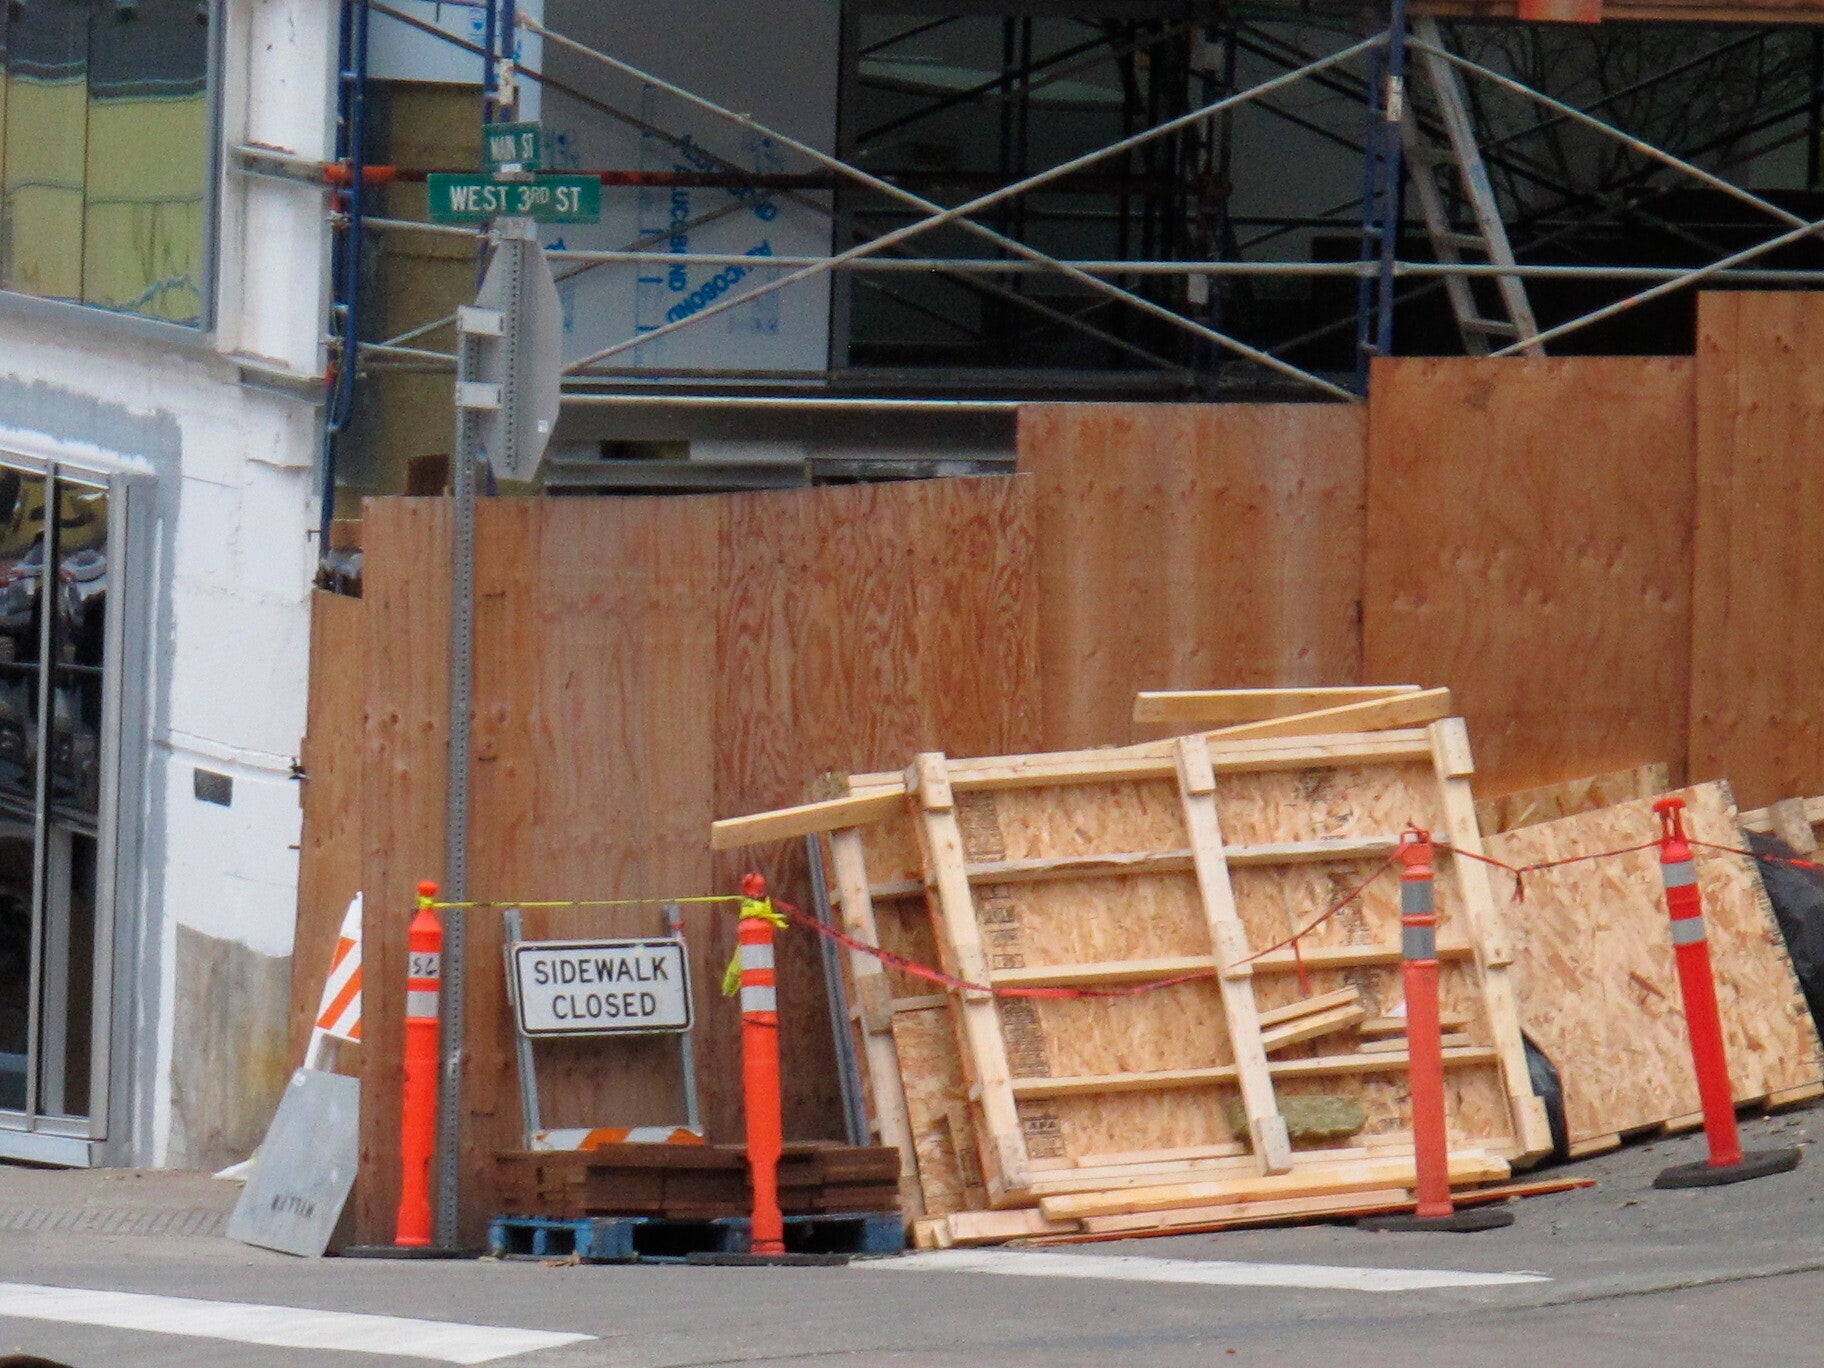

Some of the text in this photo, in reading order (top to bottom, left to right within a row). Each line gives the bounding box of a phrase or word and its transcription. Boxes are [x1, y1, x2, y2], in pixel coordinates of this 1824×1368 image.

[521, 132, 534, 159] ST
[449, 185, 582, 213] WEST 3RD ST
[533, 956, 669, 985] SIDEWALK
[552, 992, 657, 1020] CLOSED
